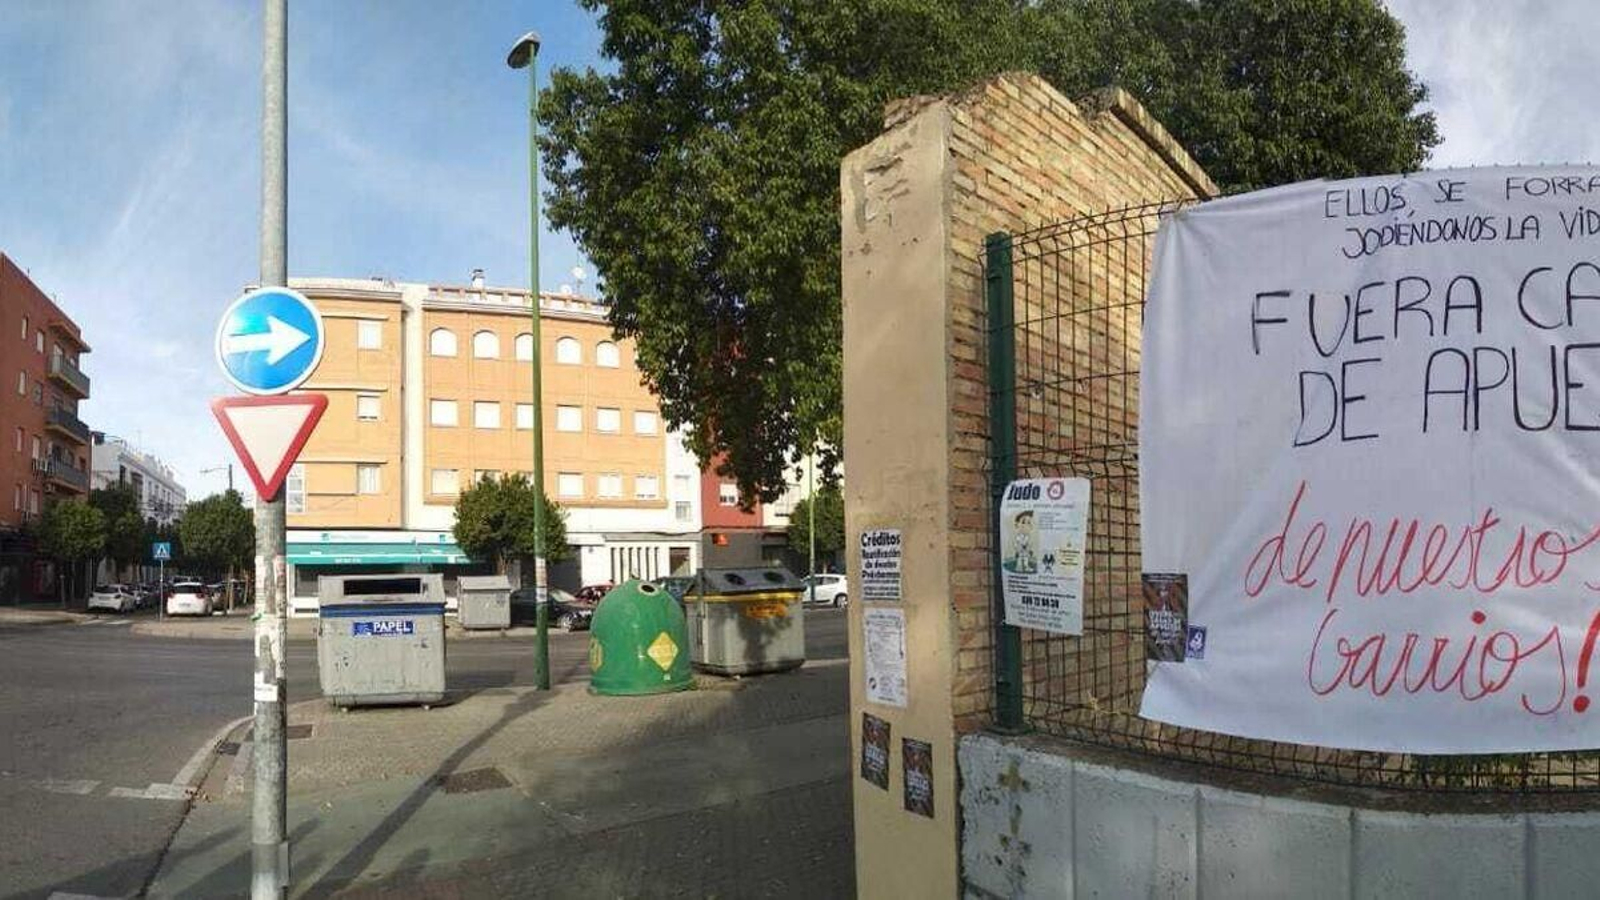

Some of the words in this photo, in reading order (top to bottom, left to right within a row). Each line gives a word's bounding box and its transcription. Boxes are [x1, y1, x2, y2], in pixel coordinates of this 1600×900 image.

[1433, 178, 1467, 204] SE
[1505, 214, 1540, 241] LA
[1250, 275, 1483, 357] FUERA
[1517, 261, 1600, 330] CA
[1293, 357, 1382, 448] DE
[1422, 343, 1600, 432] APUE
[1007, 482, 1041, 501] Judo
[860, 532, 901, 547] Créditos
[372, 620, 411, 633] PAPEL
